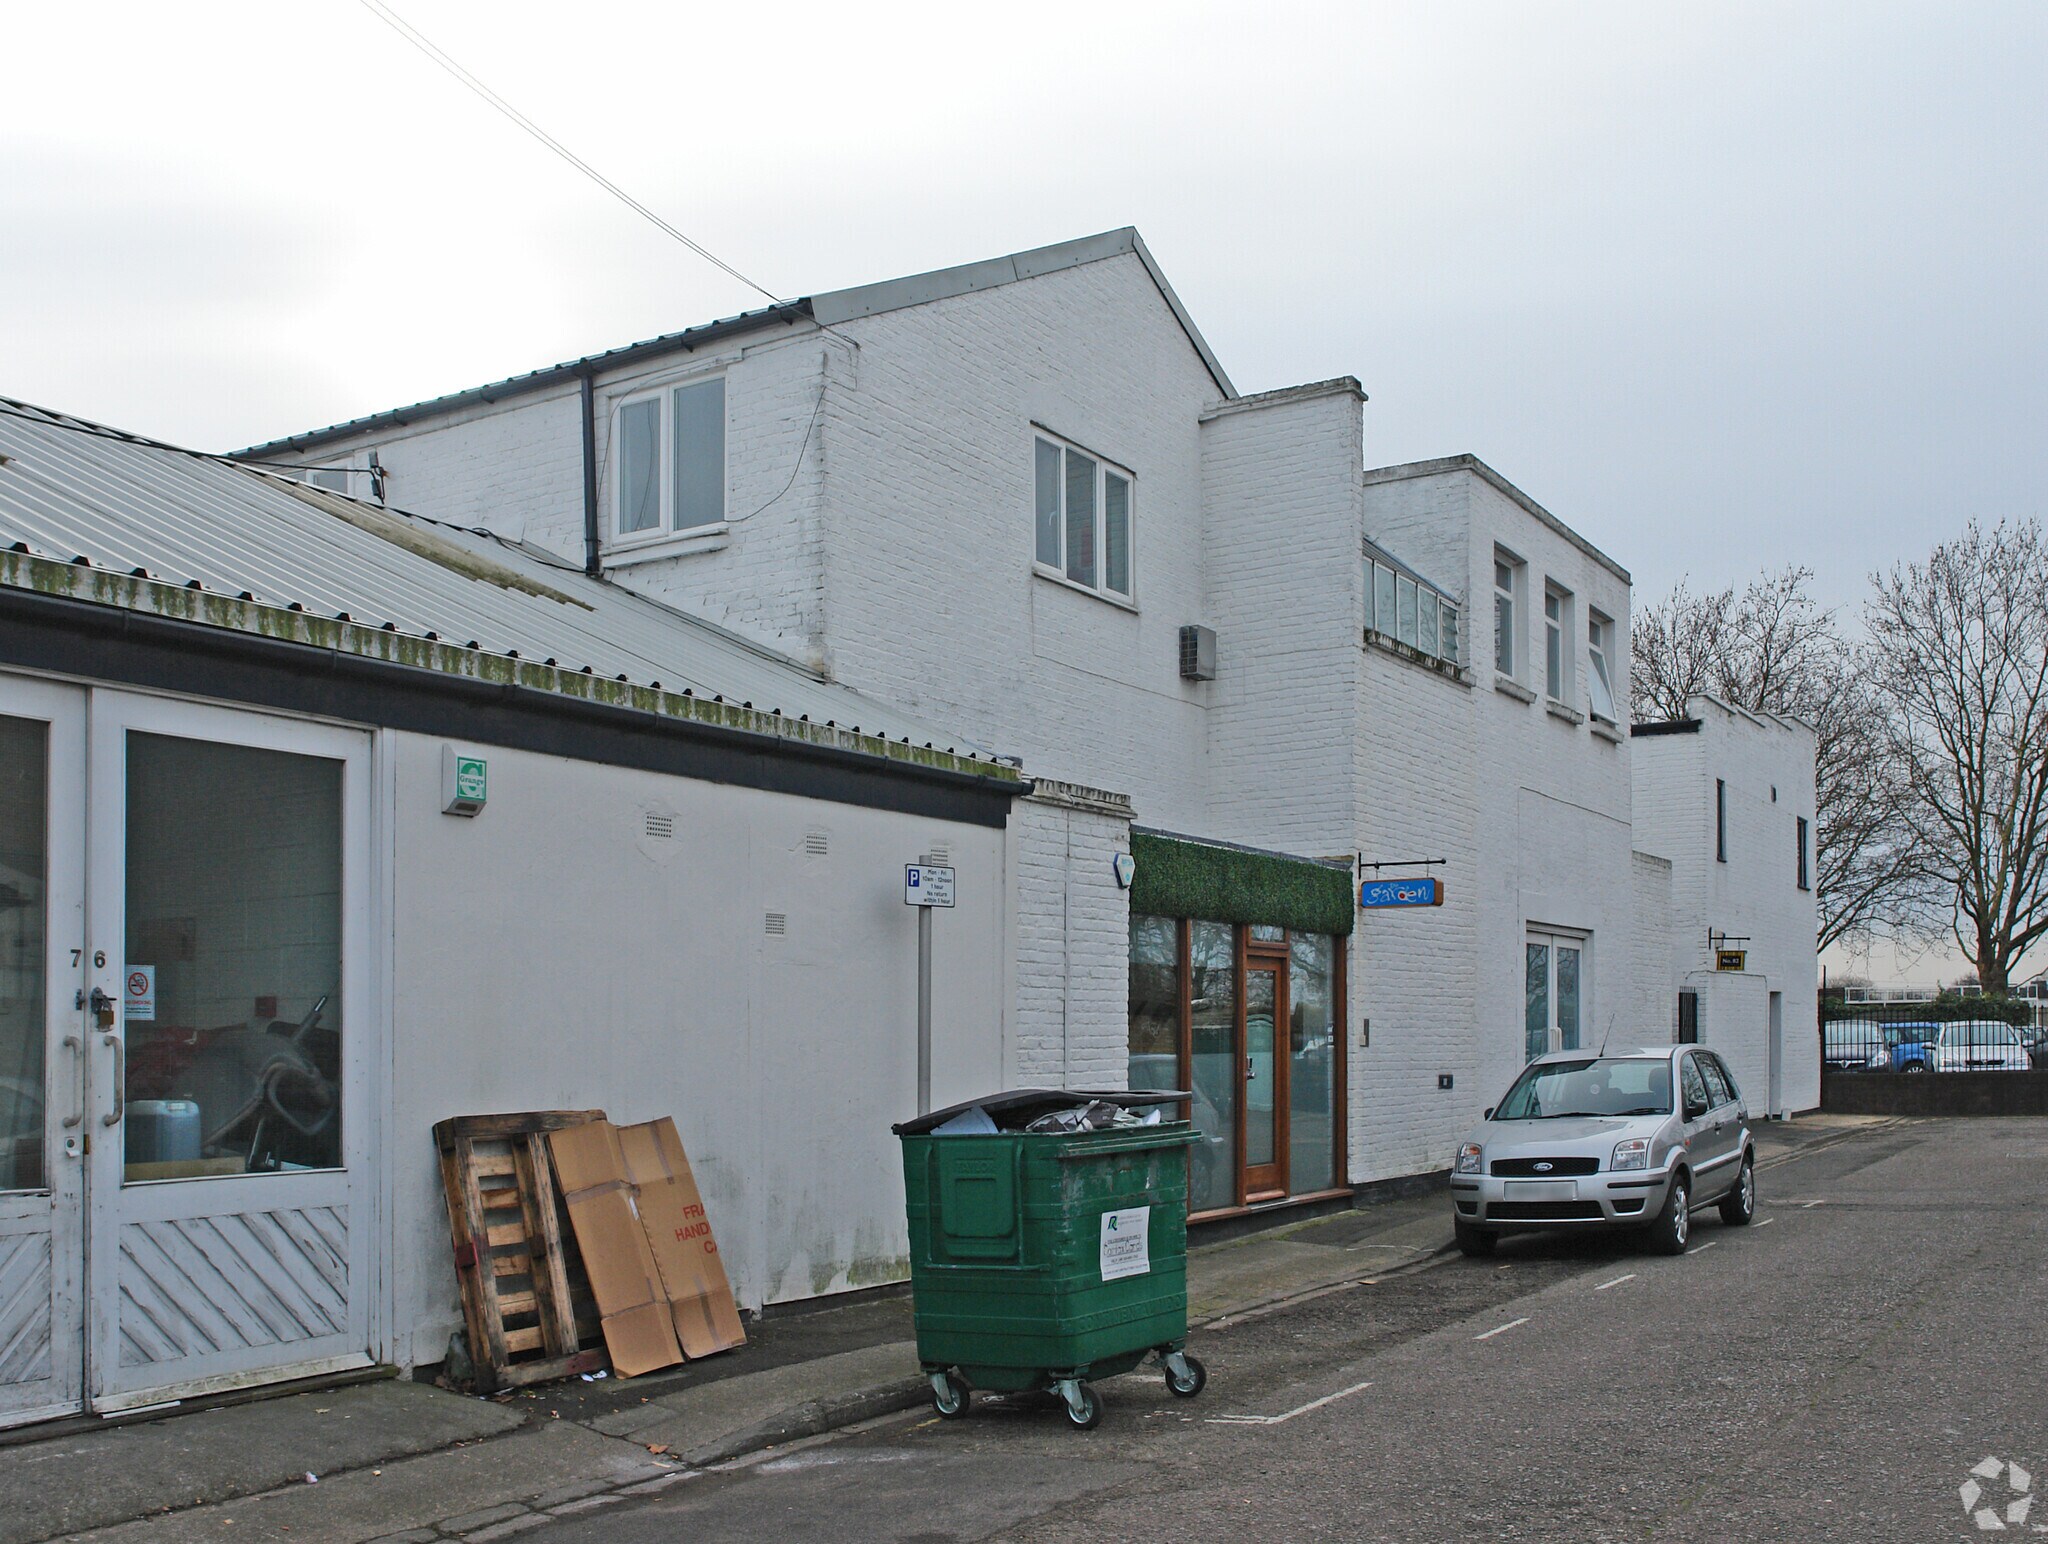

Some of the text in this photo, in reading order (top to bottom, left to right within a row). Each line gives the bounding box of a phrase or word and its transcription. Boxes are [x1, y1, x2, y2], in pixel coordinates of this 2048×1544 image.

[1366, 884, 1432, 905] garden
[71, 949, 106, 968] 7 6
